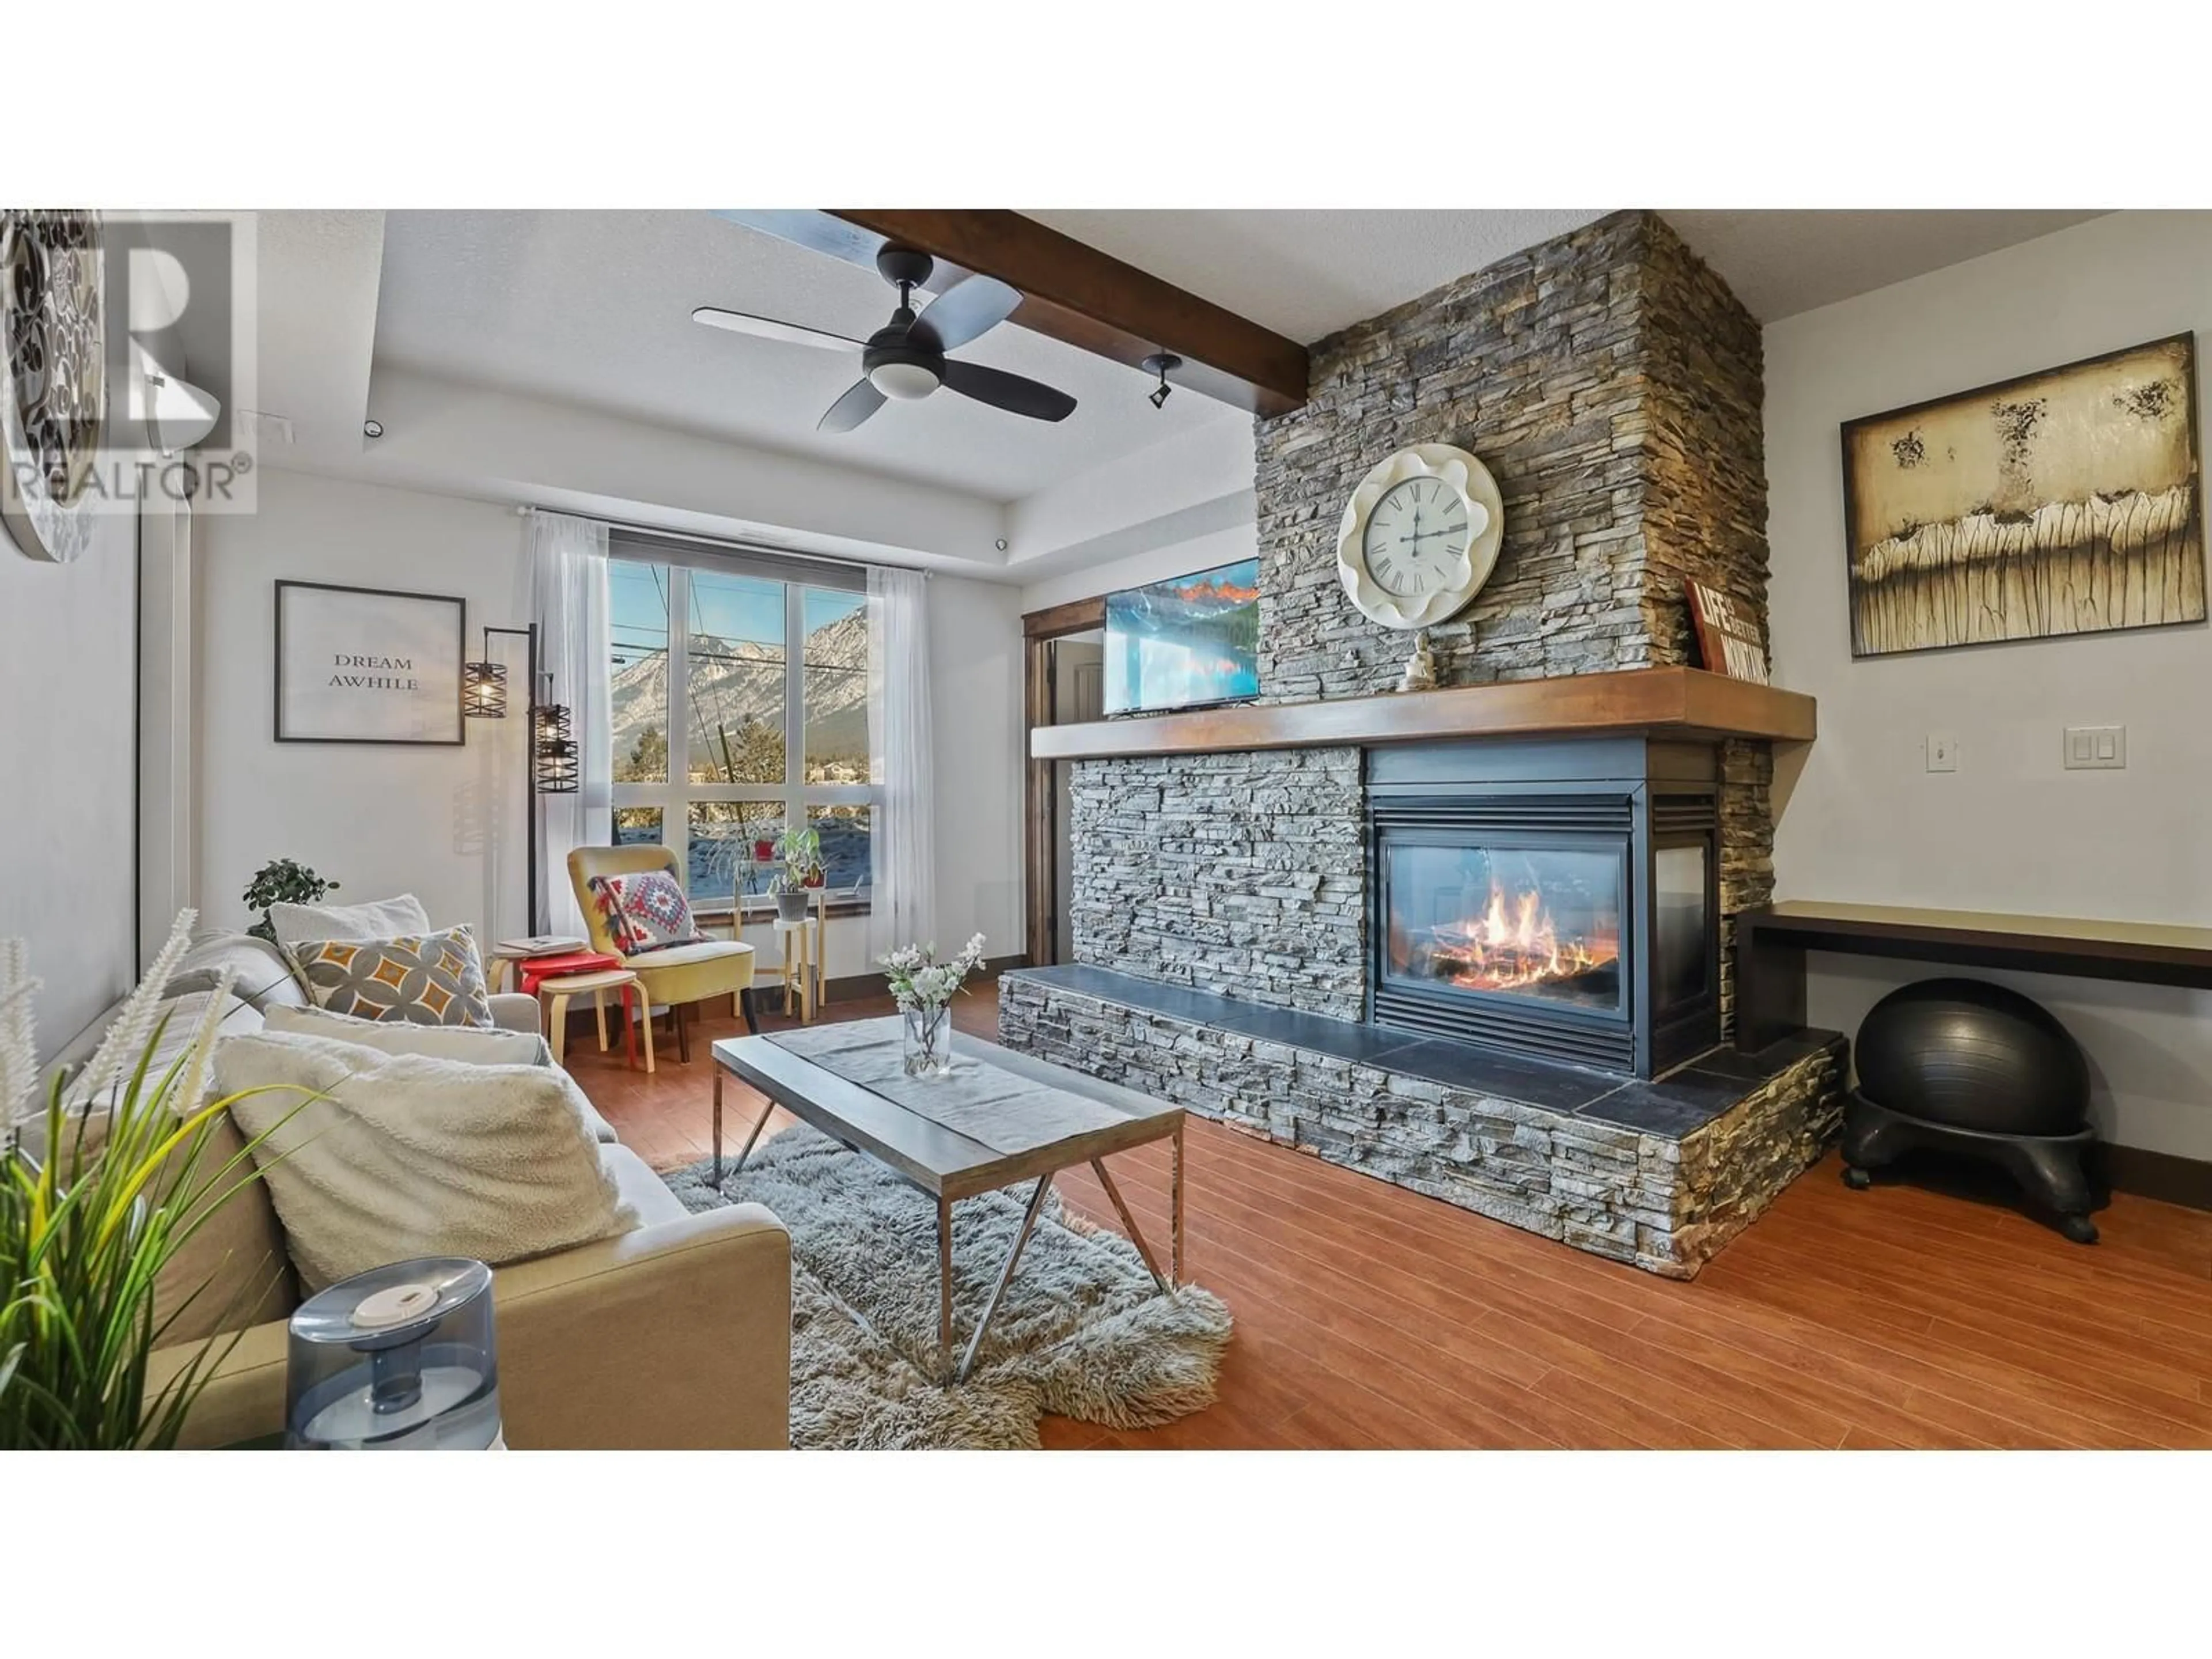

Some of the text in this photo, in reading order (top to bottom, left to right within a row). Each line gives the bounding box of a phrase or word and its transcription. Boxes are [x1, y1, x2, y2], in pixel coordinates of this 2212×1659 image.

[1693, 582, 1732, 632] LIFE
[334, 654, 412, 670] DREAM
[328, 674, 419, 690] AWHILE
